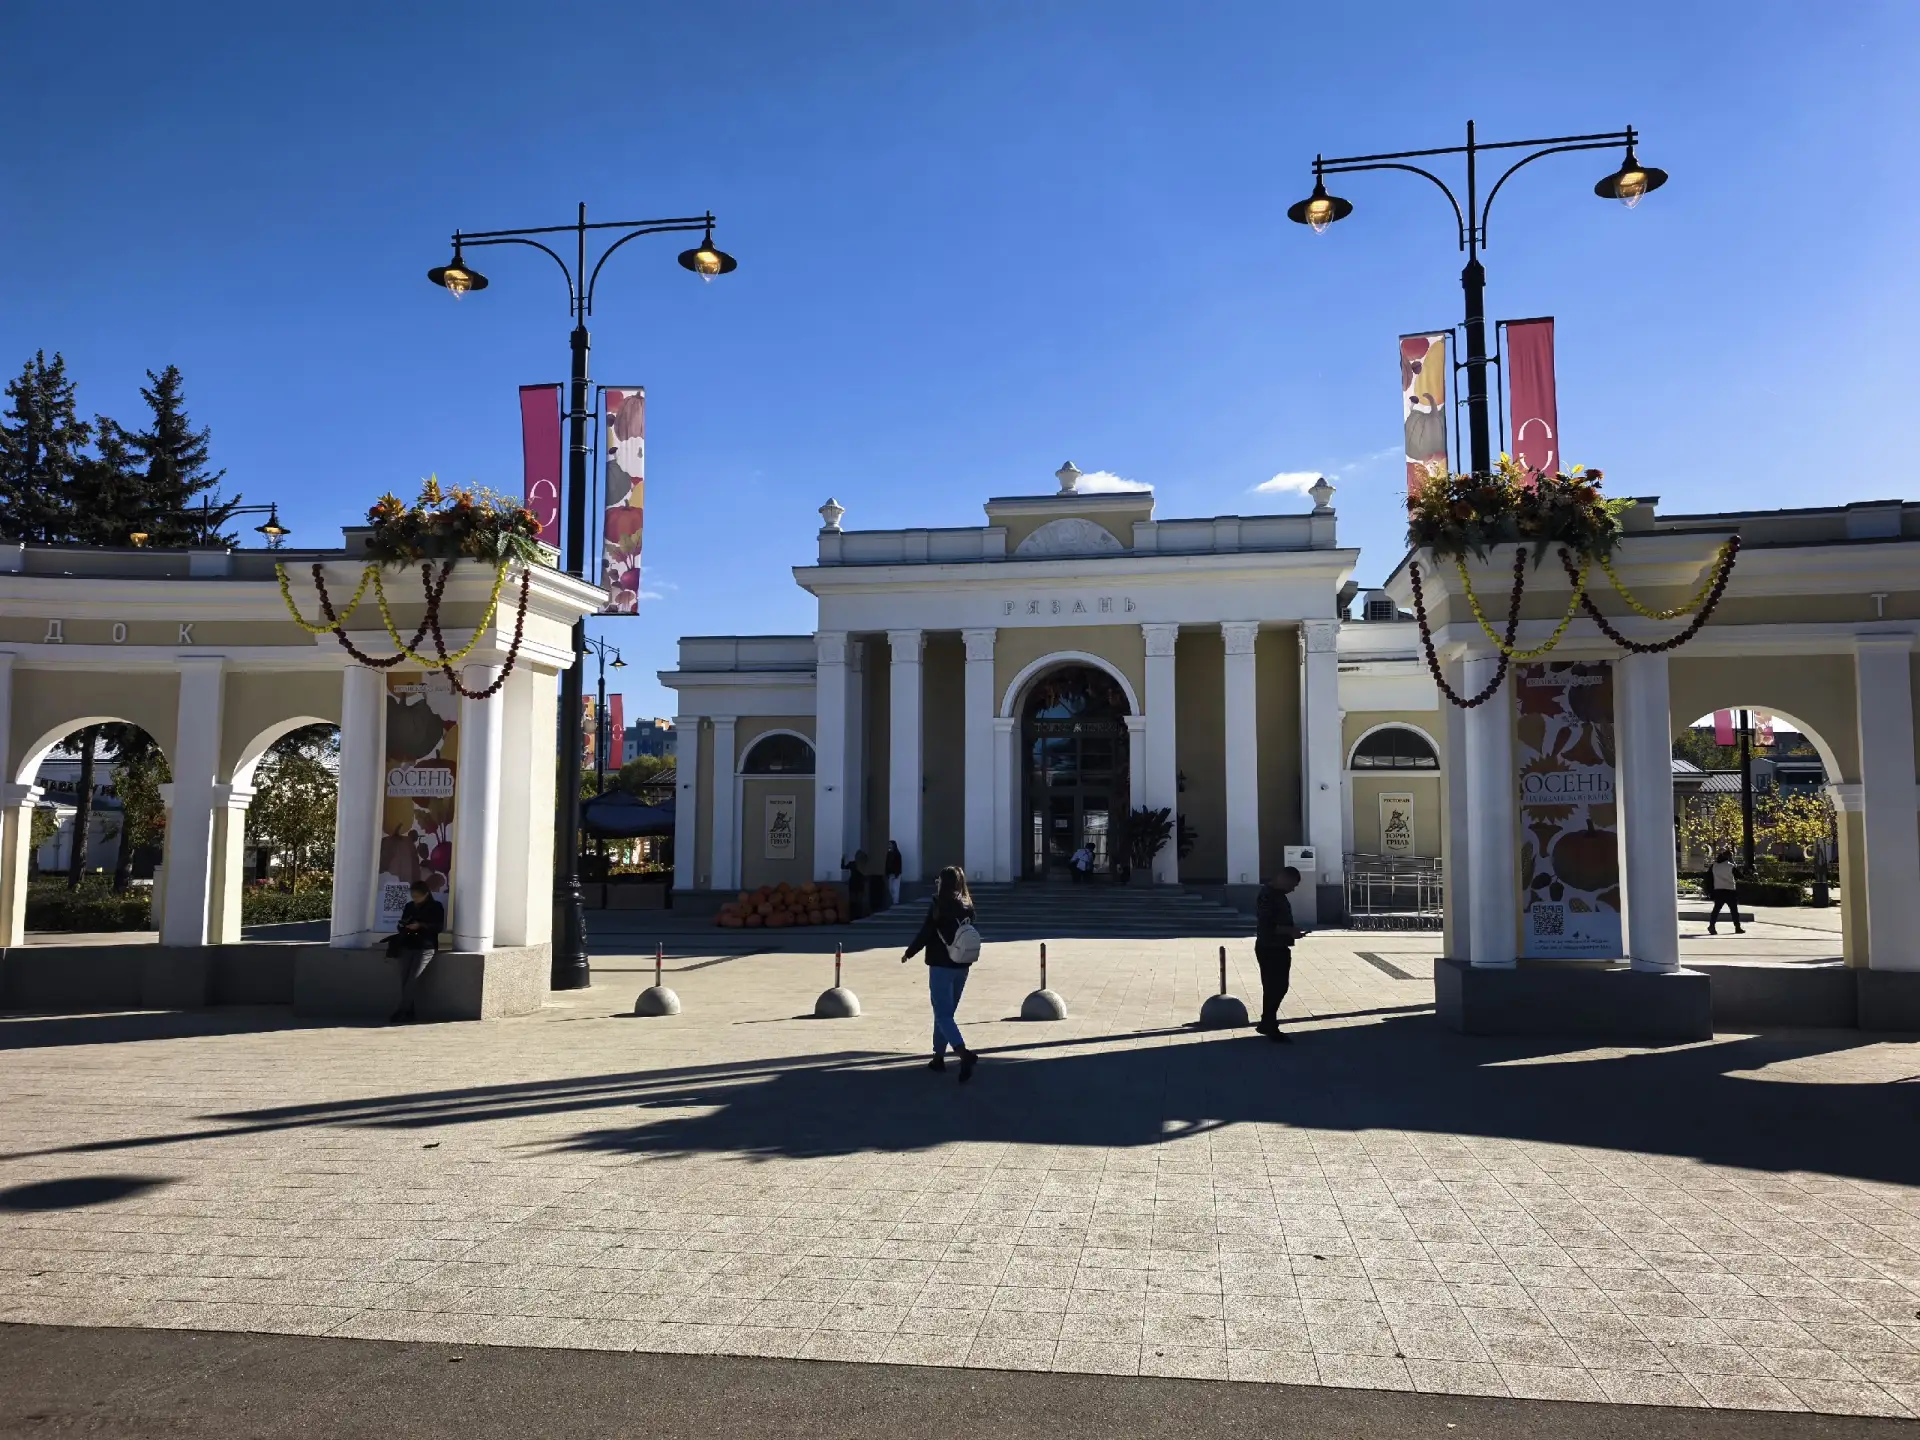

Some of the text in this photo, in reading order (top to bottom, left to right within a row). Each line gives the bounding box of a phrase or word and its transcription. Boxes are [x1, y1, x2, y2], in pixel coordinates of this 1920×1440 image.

[1003, 597, 1136, 616] РЯЗАНЬ
[43, 619, 195, 645] ДОК
[389, 769, 453, 788] ОСЕНЬ
[1525, 773, 1610, 794] ОСЕНЬ
